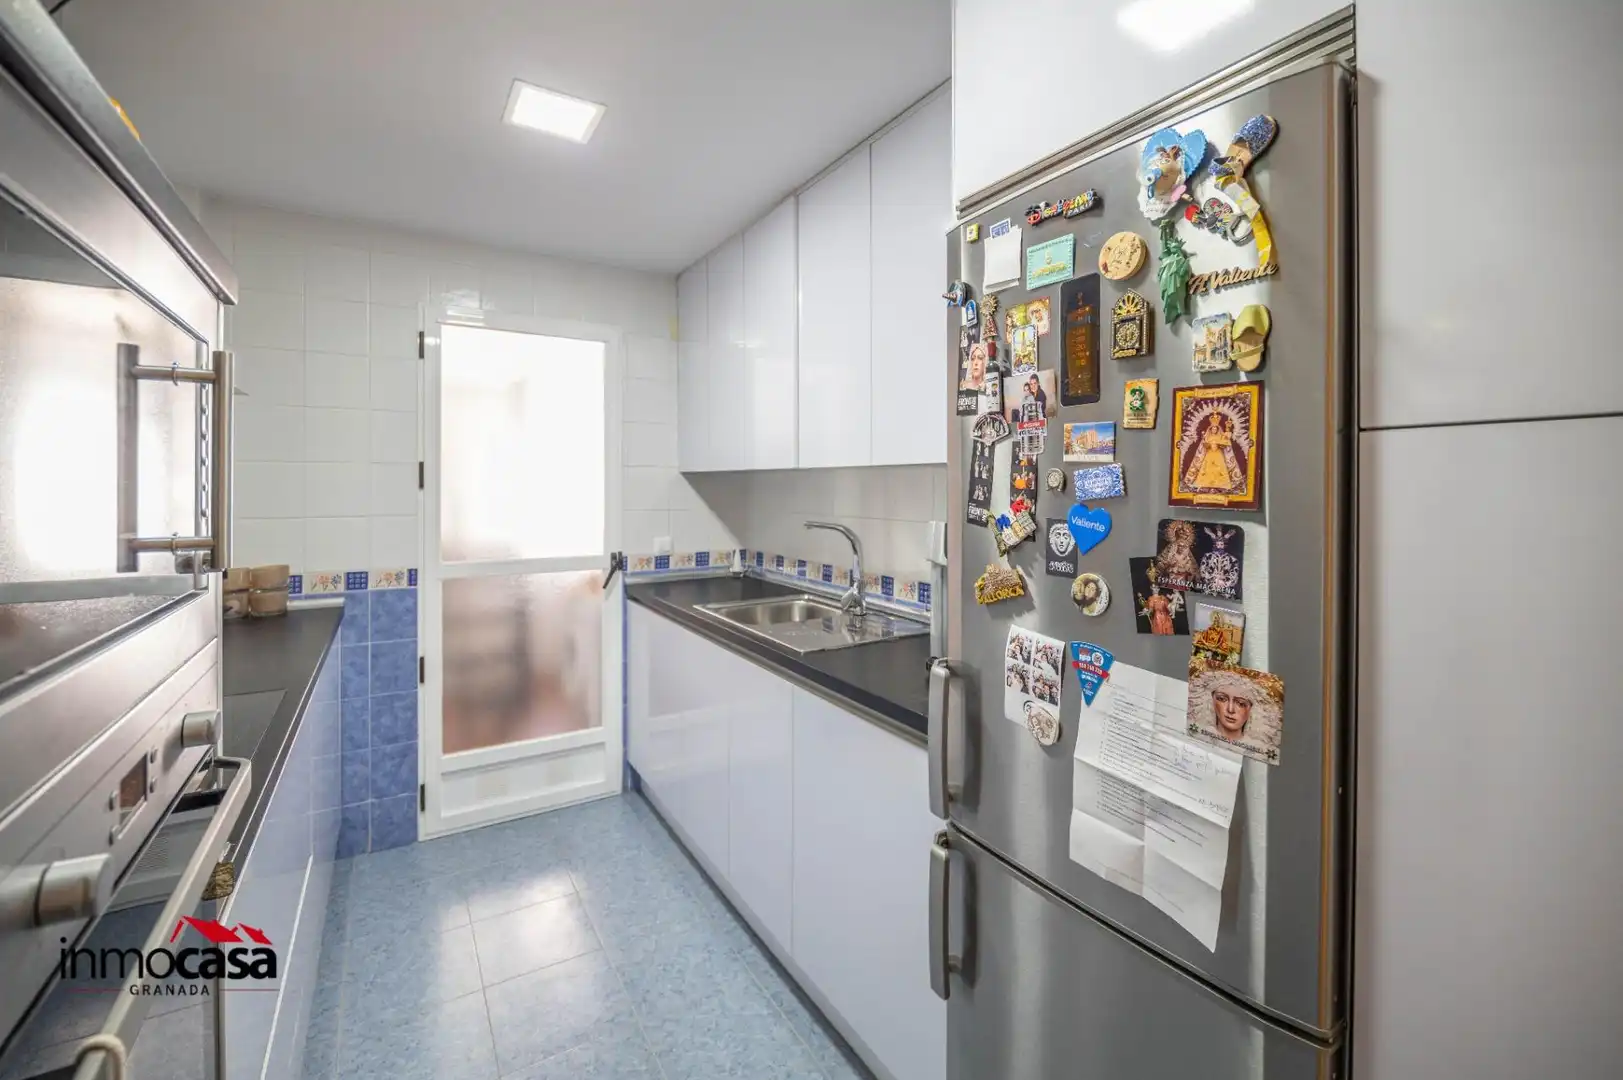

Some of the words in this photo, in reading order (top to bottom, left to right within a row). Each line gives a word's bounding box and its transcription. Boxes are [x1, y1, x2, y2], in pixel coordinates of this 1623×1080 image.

[1209, 262, 1279, 290] Valiente
[1071, 515, 1105, 533] Valiente
[1157, 576, 1194, 589] ESPERANZA
[1196, 582, 1237, 595] MACARENA
[978, 587, 1024, 604] MALLORCA
